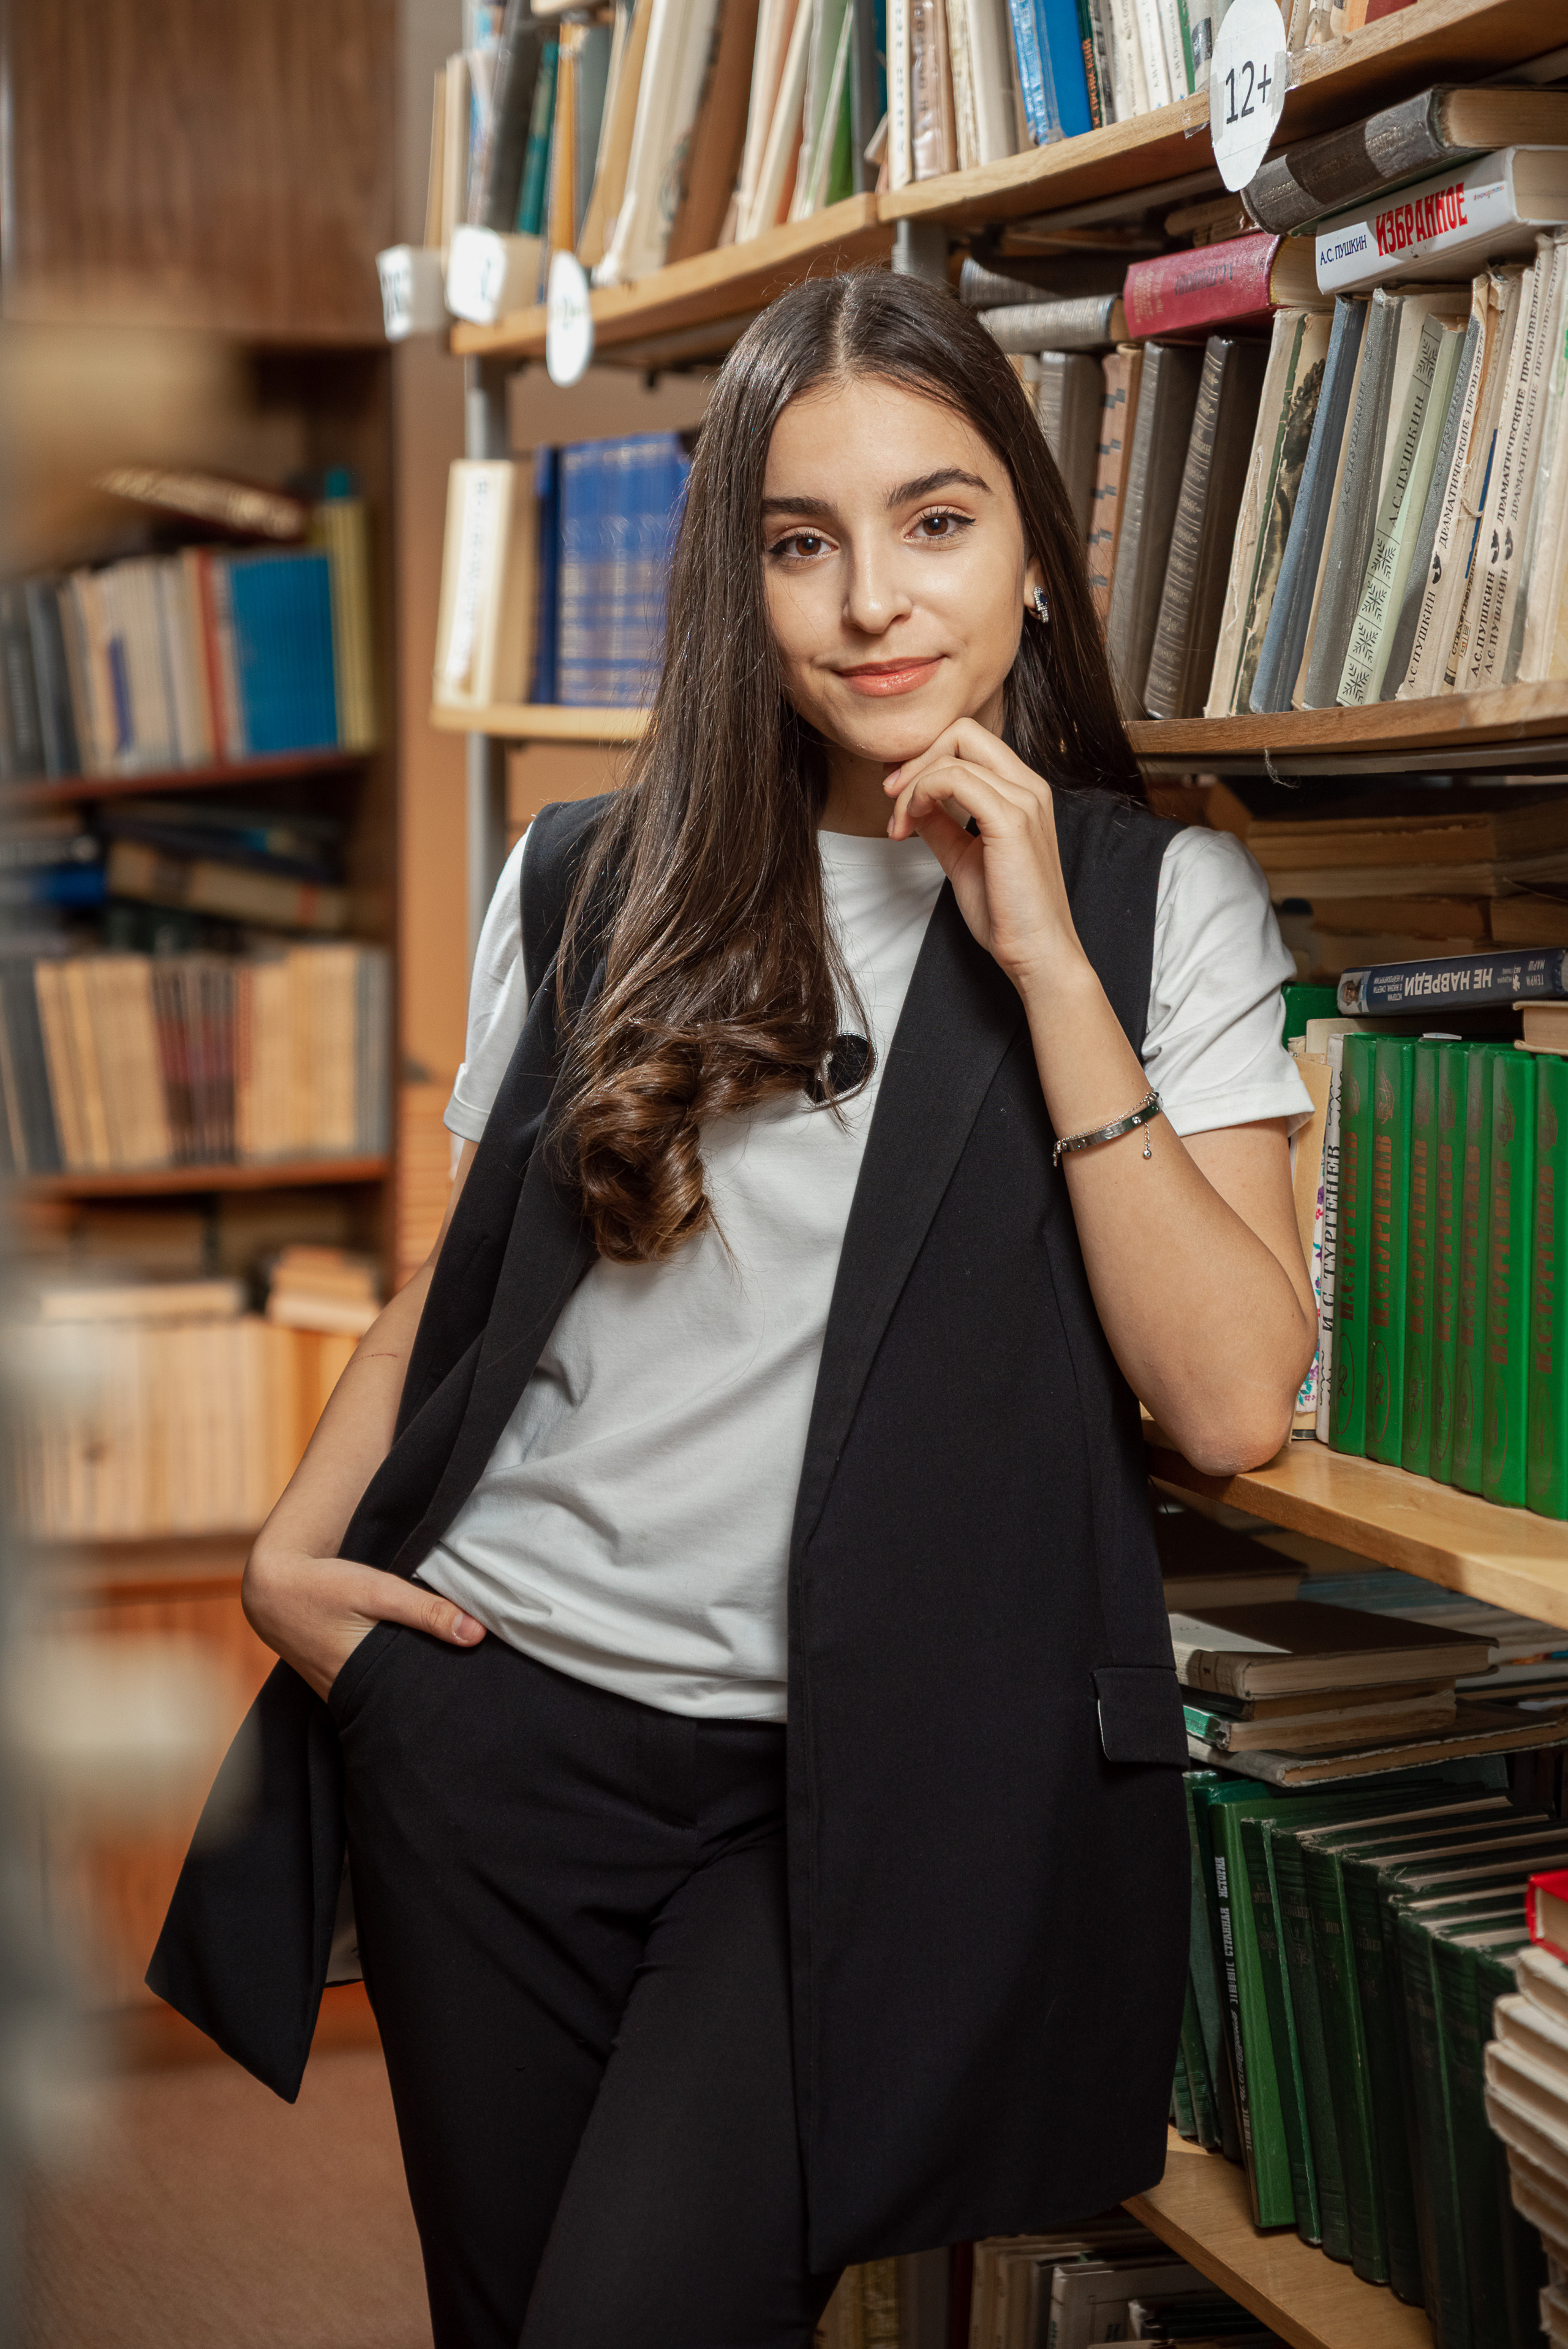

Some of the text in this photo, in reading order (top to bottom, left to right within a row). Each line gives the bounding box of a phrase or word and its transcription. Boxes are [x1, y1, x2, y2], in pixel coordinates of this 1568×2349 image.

[1226, 61, 1272, 124] 12+
[1335, 235, 1367, 259] ПУШКИН
[1376, 182, 1468, 257] ИЗБРАННОЕ
[1439, 419, 1470, 548] ДРАМАТИЧЕСКИЕ
[1497, 389, 1526, 525] ДРАМАТИЧЕСКИЕ
[1510, 384, 1539, 521] ДРАМАТИЧЕСКИЕ
[1404, 968, 1493, 996] НЕ НАВРЕДИ
[1526, 974, 1544, 986] ГЕНРИ
[1528, 960, 1545, 971] МАРШ
[1324, 1144, 1340, 1279] ТУРГЕНЕВ
[1215, 1856, 1234, 1957] СТРАННАЯ ИСТОРИЯ
